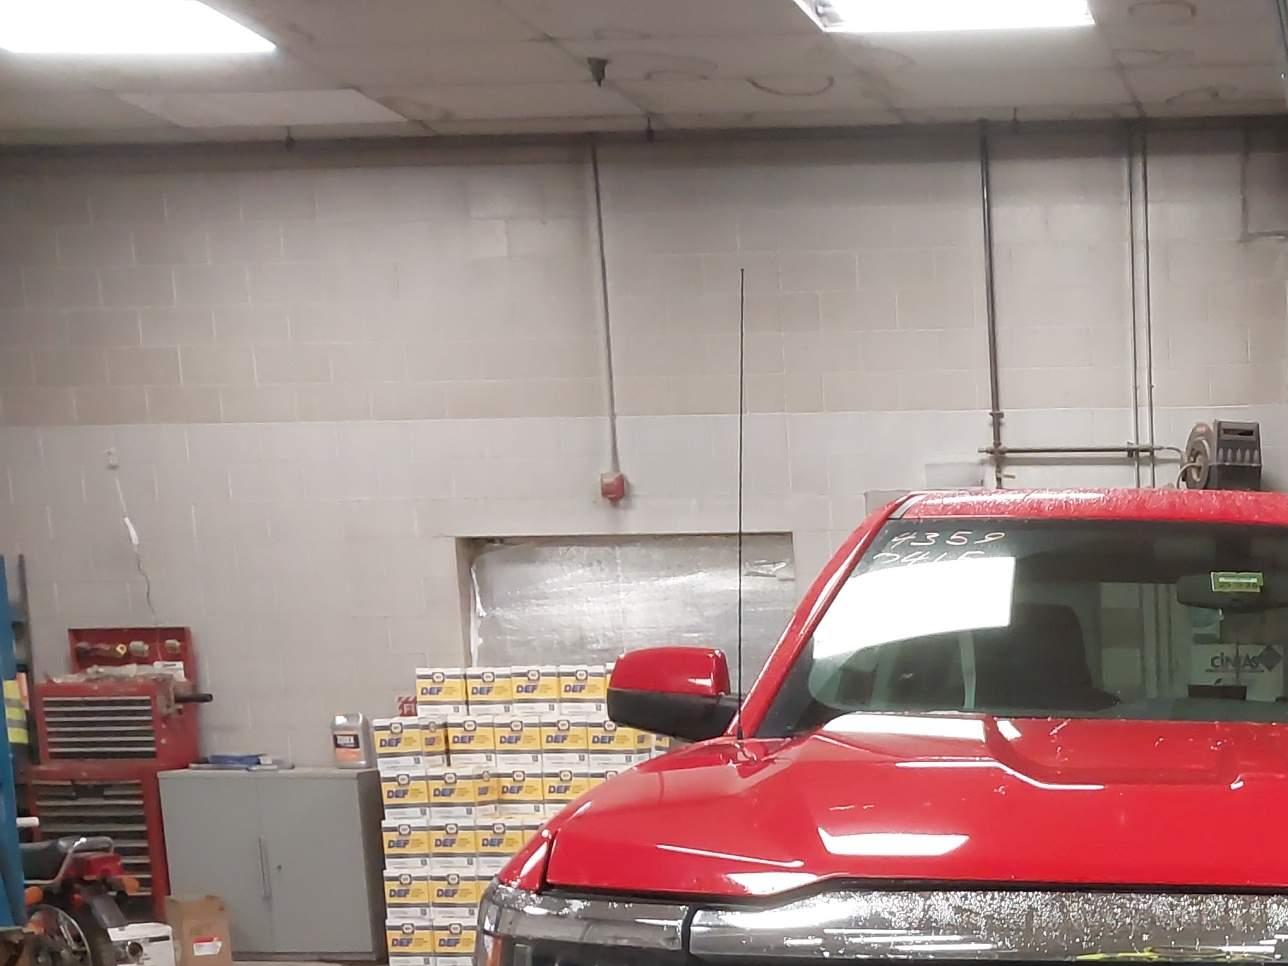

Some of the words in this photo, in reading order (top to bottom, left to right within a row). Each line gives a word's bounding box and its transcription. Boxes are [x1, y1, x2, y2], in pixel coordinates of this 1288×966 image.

[420, 686, 442, 696] DEF
[471, 686, 492, 696] DEF
[516, 684, 538, 694] DEF
[564, 684, 586, 693] DEF
[380, 737, 401, 748] DEF
[452, 734, 474, 744] DEF
[499, 735, 522, 744] DEF
[546, 734, 568, 744] DEF
[592, 735, 615, 744] DEF
[386, 788, 408, 798] DEF
[433, 788, 454, 797] DEF
[502, 785, 523, 794] DEF
[548, 784, 570, 794] DEF
[388, 839, 410, 848] DEF
[434, 838, 456, 847] DEF
[482, 838, 504, 847] DEF
[389, 888, 410, 898] DEF
[436, 888, 458, 898] DEF
[392, 938, 413, 947] DEF
[438, 938, 460, 947] DEF
